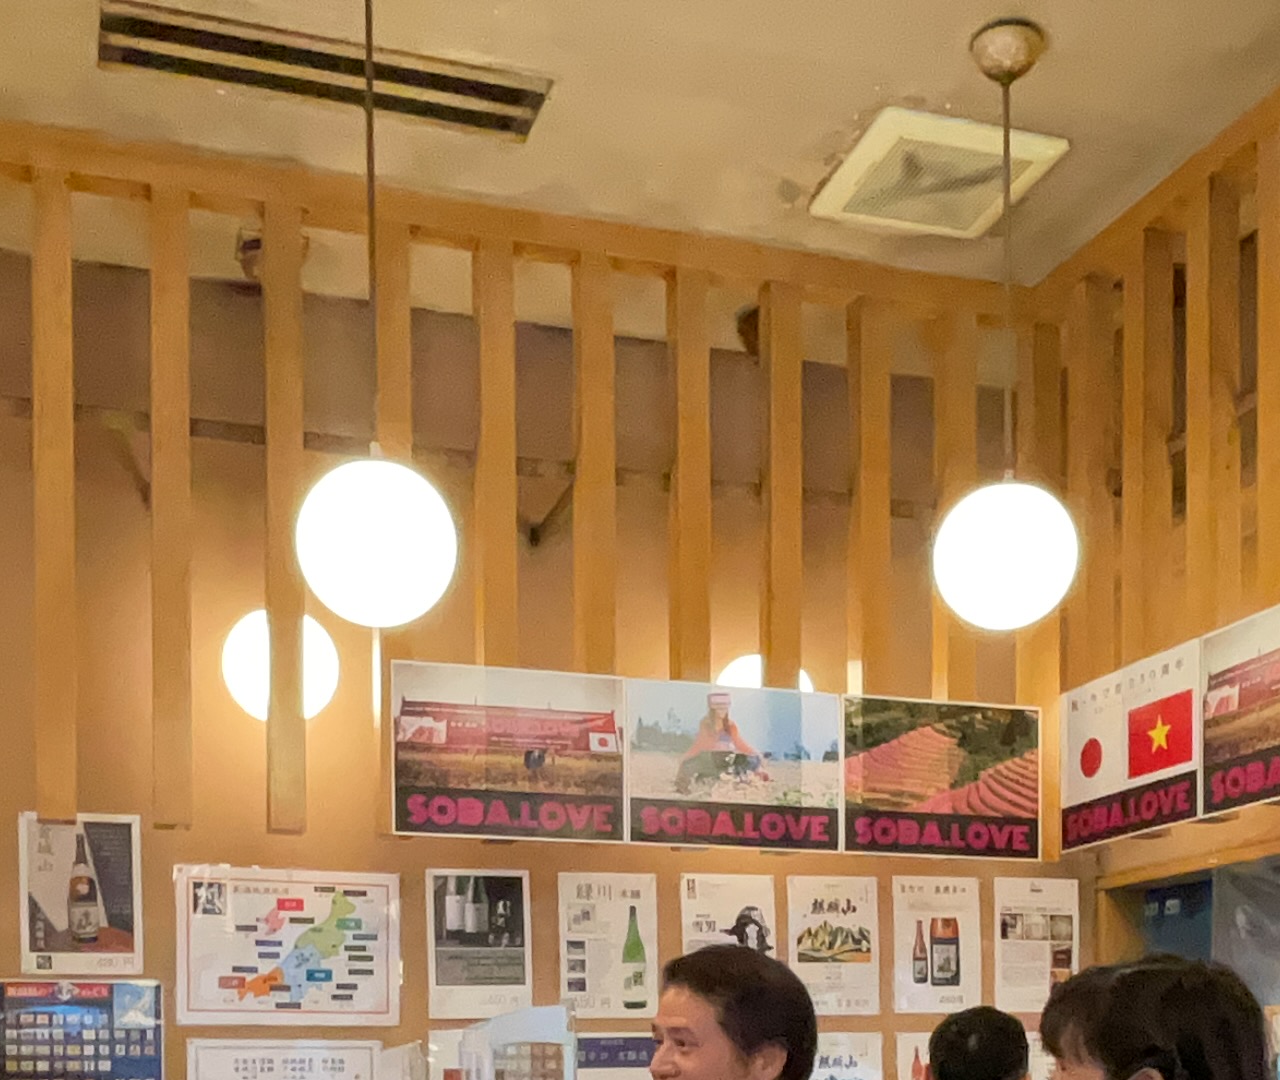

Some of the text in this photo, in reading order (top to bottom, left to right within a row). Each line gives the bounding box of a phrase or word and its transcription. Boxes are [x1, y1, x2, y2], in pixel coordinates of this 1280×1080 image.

[406, 793, 614, 833] SOBA.LOVE
[640, 805, 830, 843] SOBA.LOVE
[1066, 779, 1192, 842] SOBA.LOVE
[854, 816, 1030, 851] SOBA.LOVE
